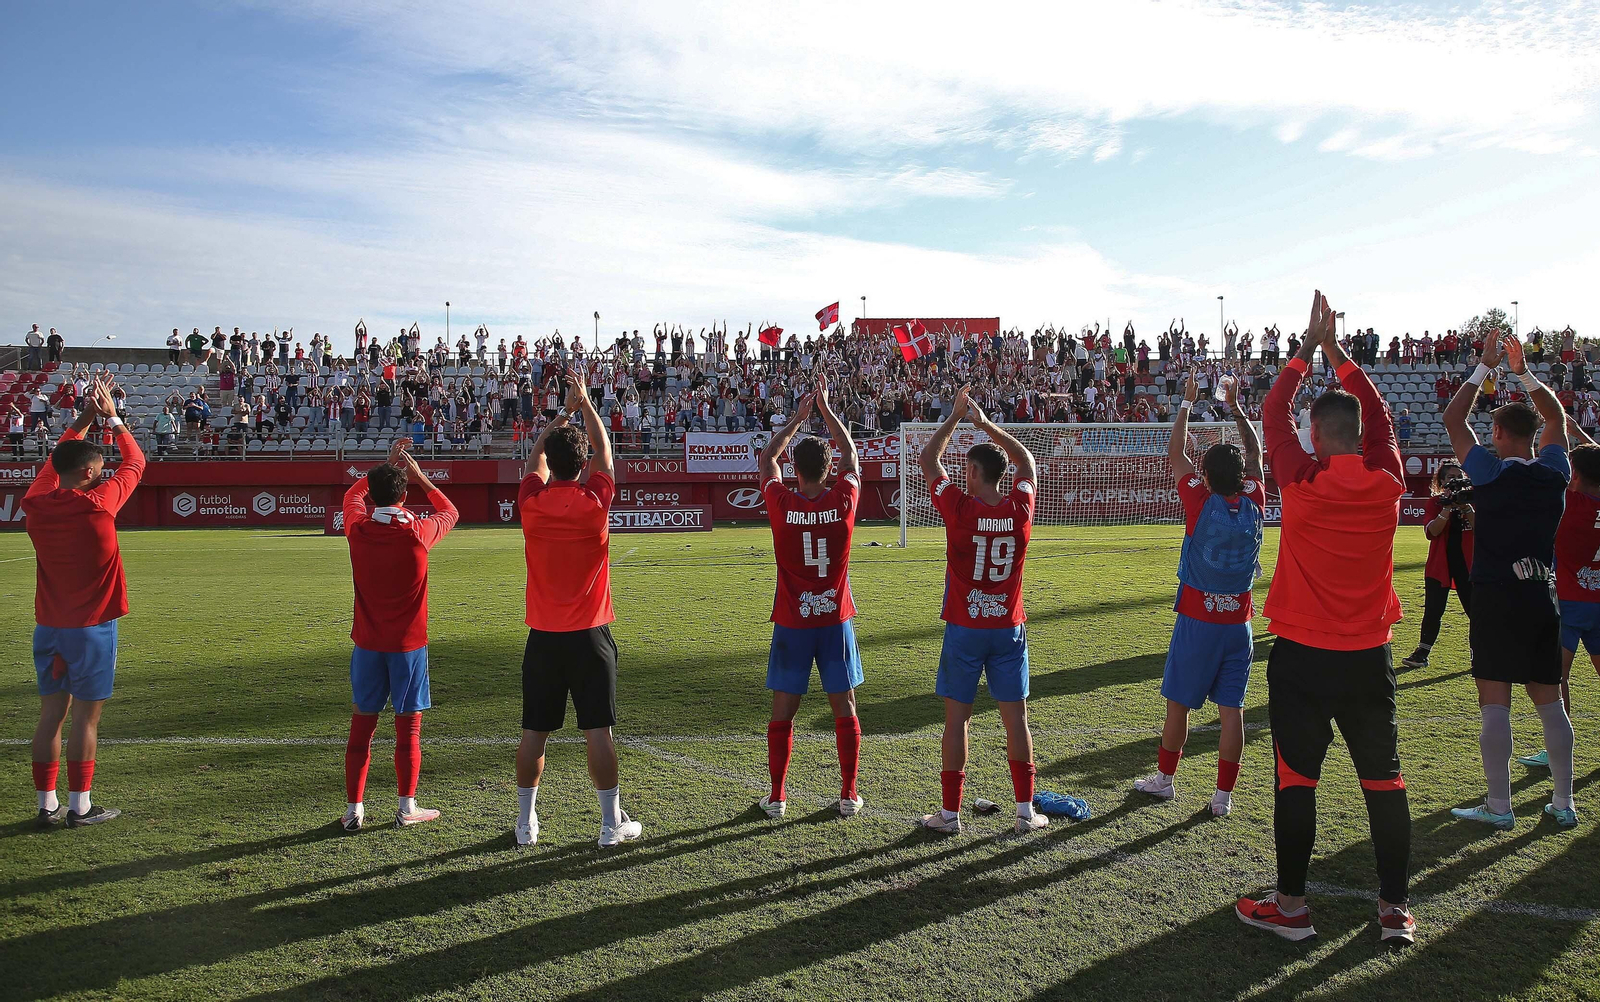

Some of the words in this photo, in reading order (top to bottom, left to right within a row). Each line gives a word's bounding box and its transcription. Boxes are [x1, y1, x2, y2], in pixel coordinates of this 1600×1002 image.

[688, 445, 749, 454] KOMANDO
[627, 461, 679, 473] MOLINO
[200, 494, 231, 504] futbol
[279, 493, 310, 504] futbol
[620, 489, 631, 501] El
[635, 489, 680, 501] Cerezo
[199, 505, 247, 515] emotion
[279, 504, 326, 514] emotion
[786, 510, 817, 525] BORJA
[977, 517, 1014, 532] MARINO
[802, 531, 831, 578] 4
[972, 535, 1016, 582] 19
